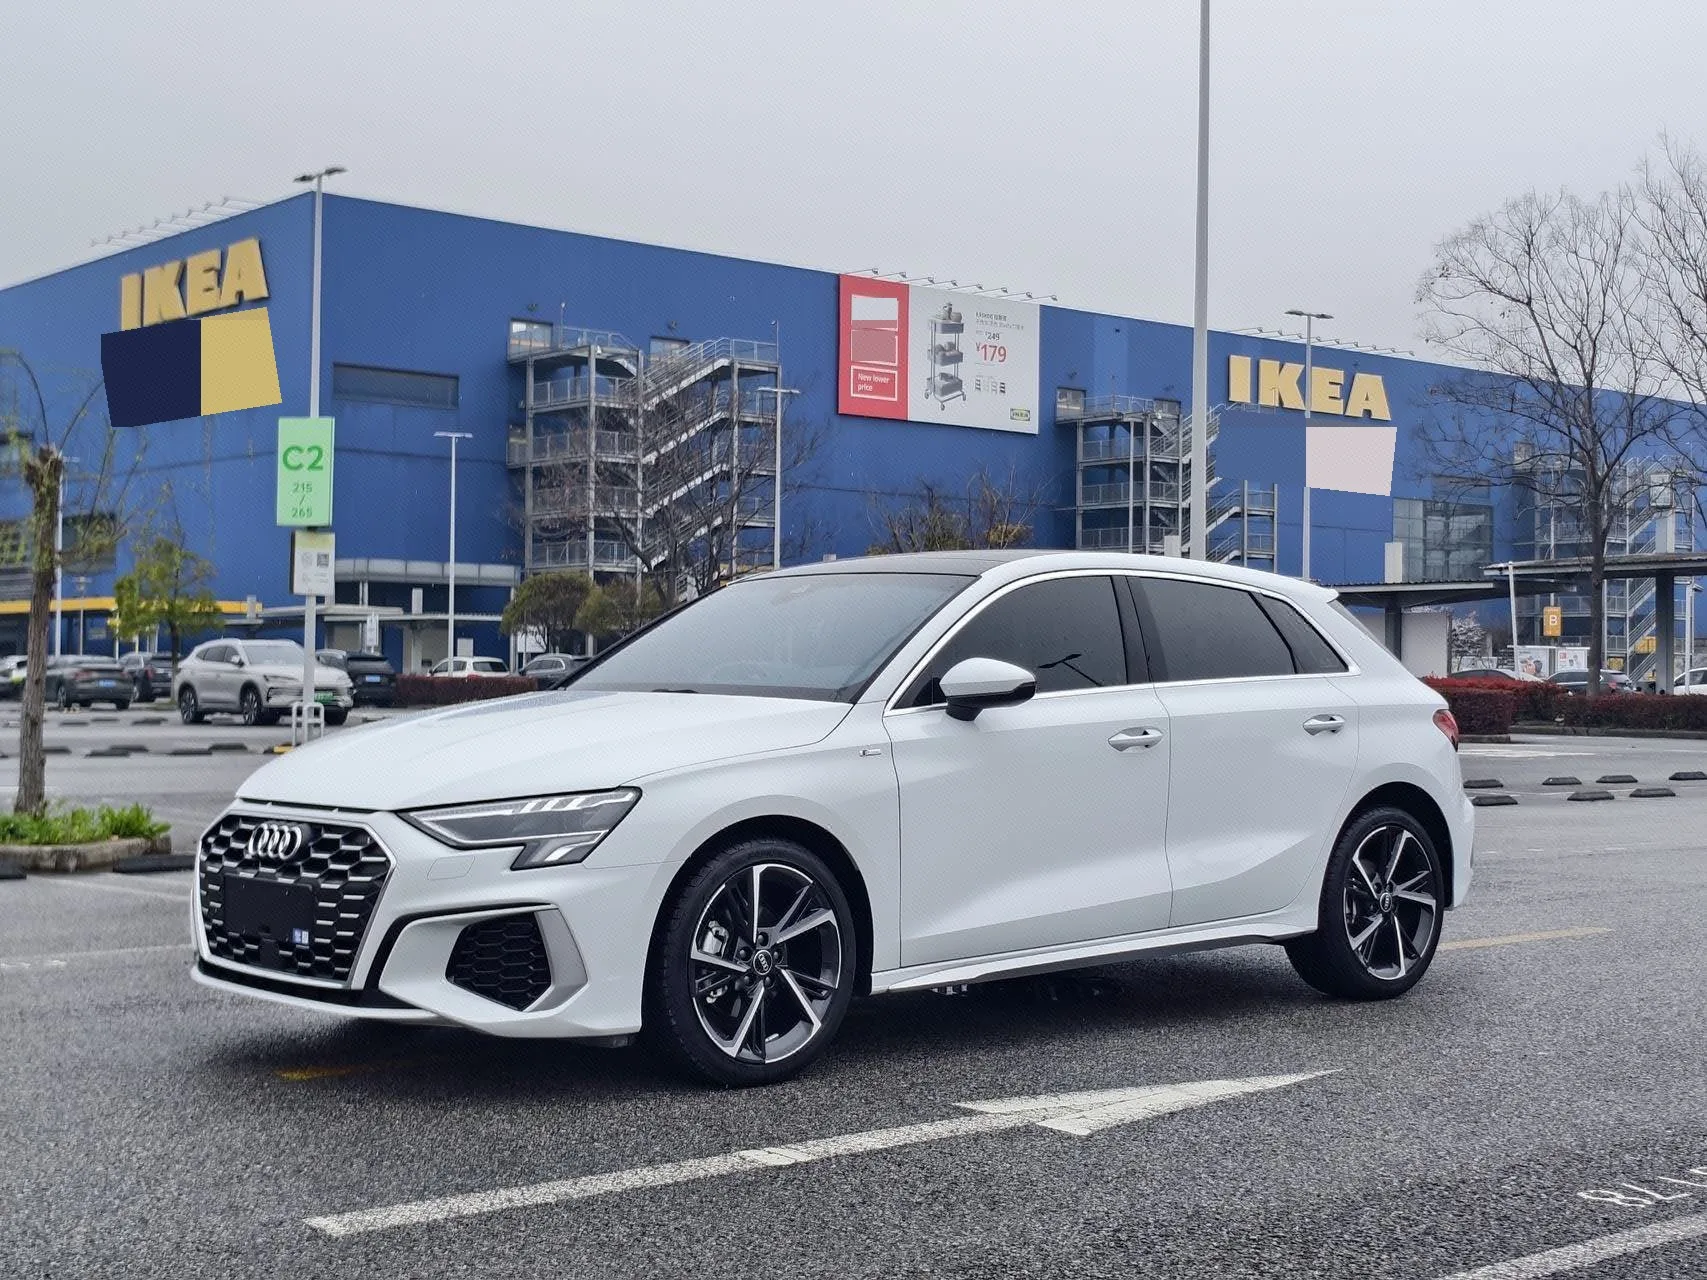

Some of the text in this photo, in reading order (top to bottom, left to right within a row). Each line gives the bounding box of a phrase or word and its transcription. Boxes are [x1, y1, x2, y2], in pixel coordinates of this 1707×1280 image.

[120, 237, 269, 331] IKEA
[975, 342, 1007, 363] ¥179
[857, 373, 890, 384] New lower
[857, 384, 873, 392] price
[1229, 354, 1391, 421] IKEA
[282, 445, 324, 471] C2
[293, 482, 312, 493] 215
[291, 507, 312, 518] 265
[1549, 614, 1558, 626] B
